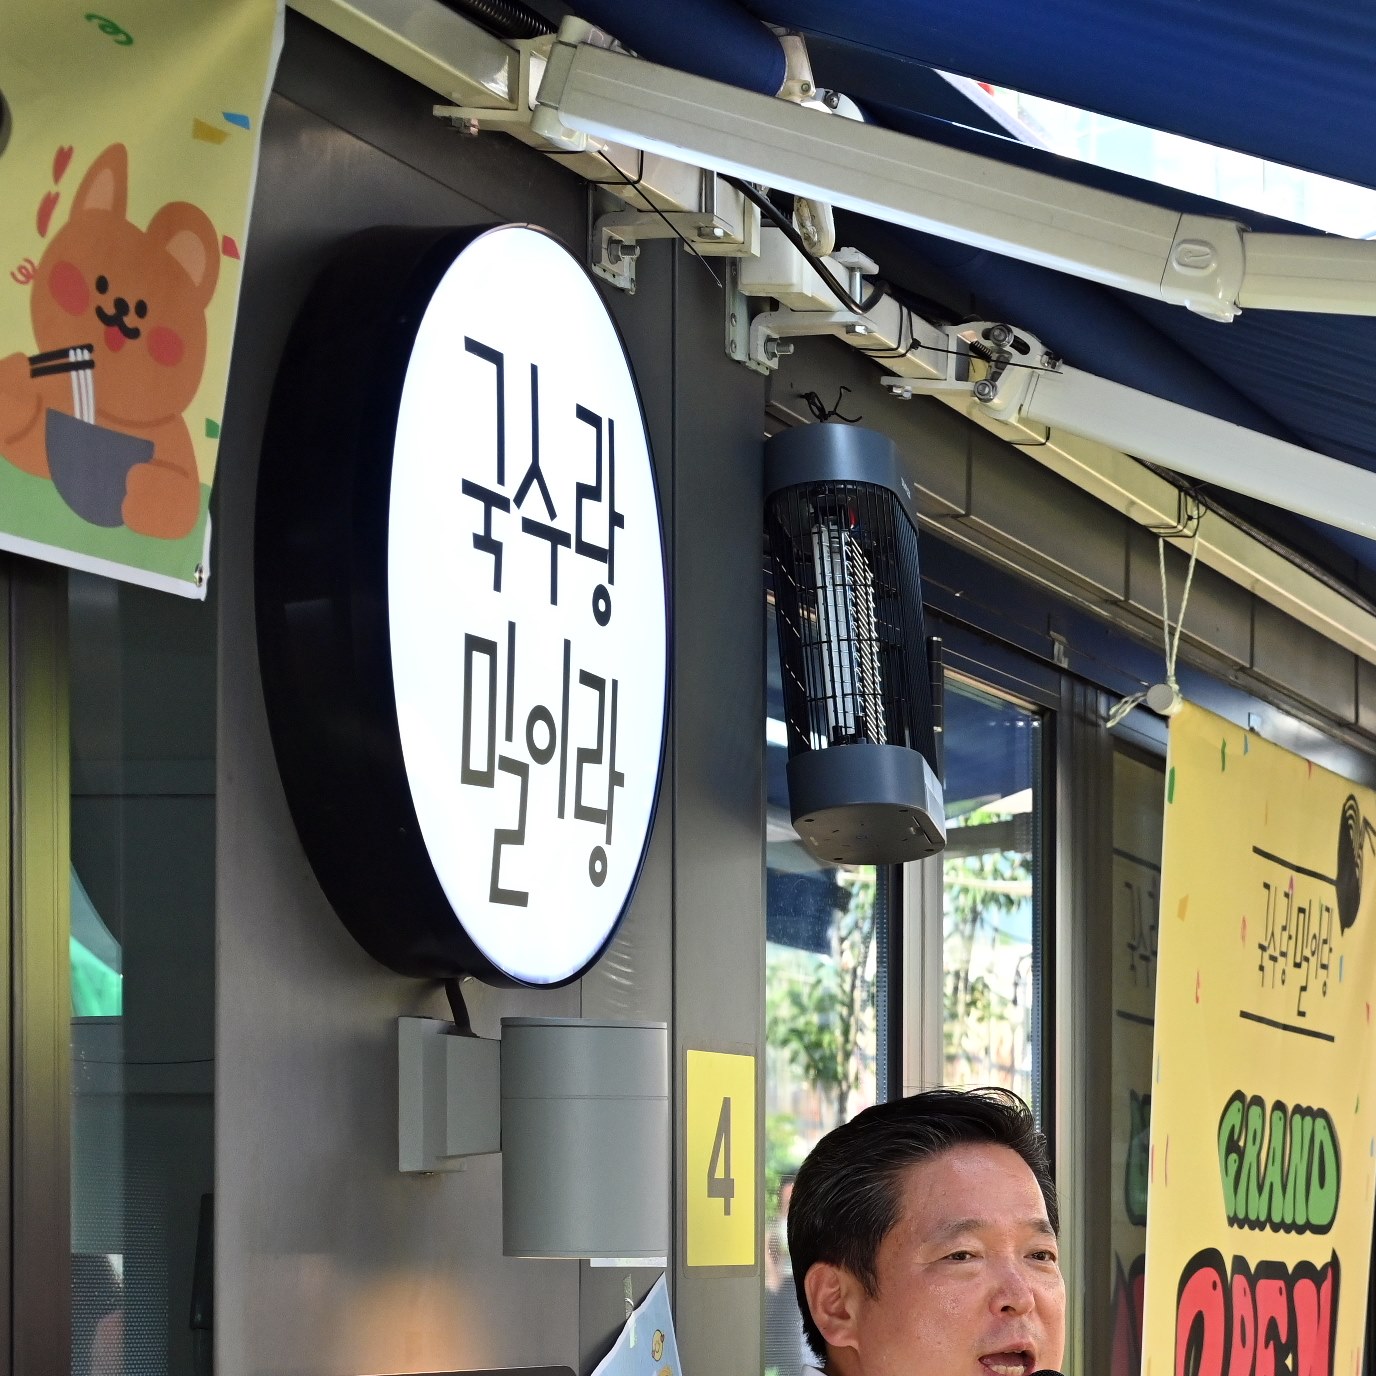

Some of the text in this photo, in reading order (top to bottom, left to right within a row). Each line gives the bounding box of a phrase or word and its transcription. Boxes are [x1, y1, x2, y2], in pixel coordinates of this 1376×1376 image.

[461, 336, 625, 627] 국수랑
[461, 621, 625, 908] 밀이랑
[706, 1096, 735, 1217] 4
[1217, 1089, 1341, 1236] GRAND
